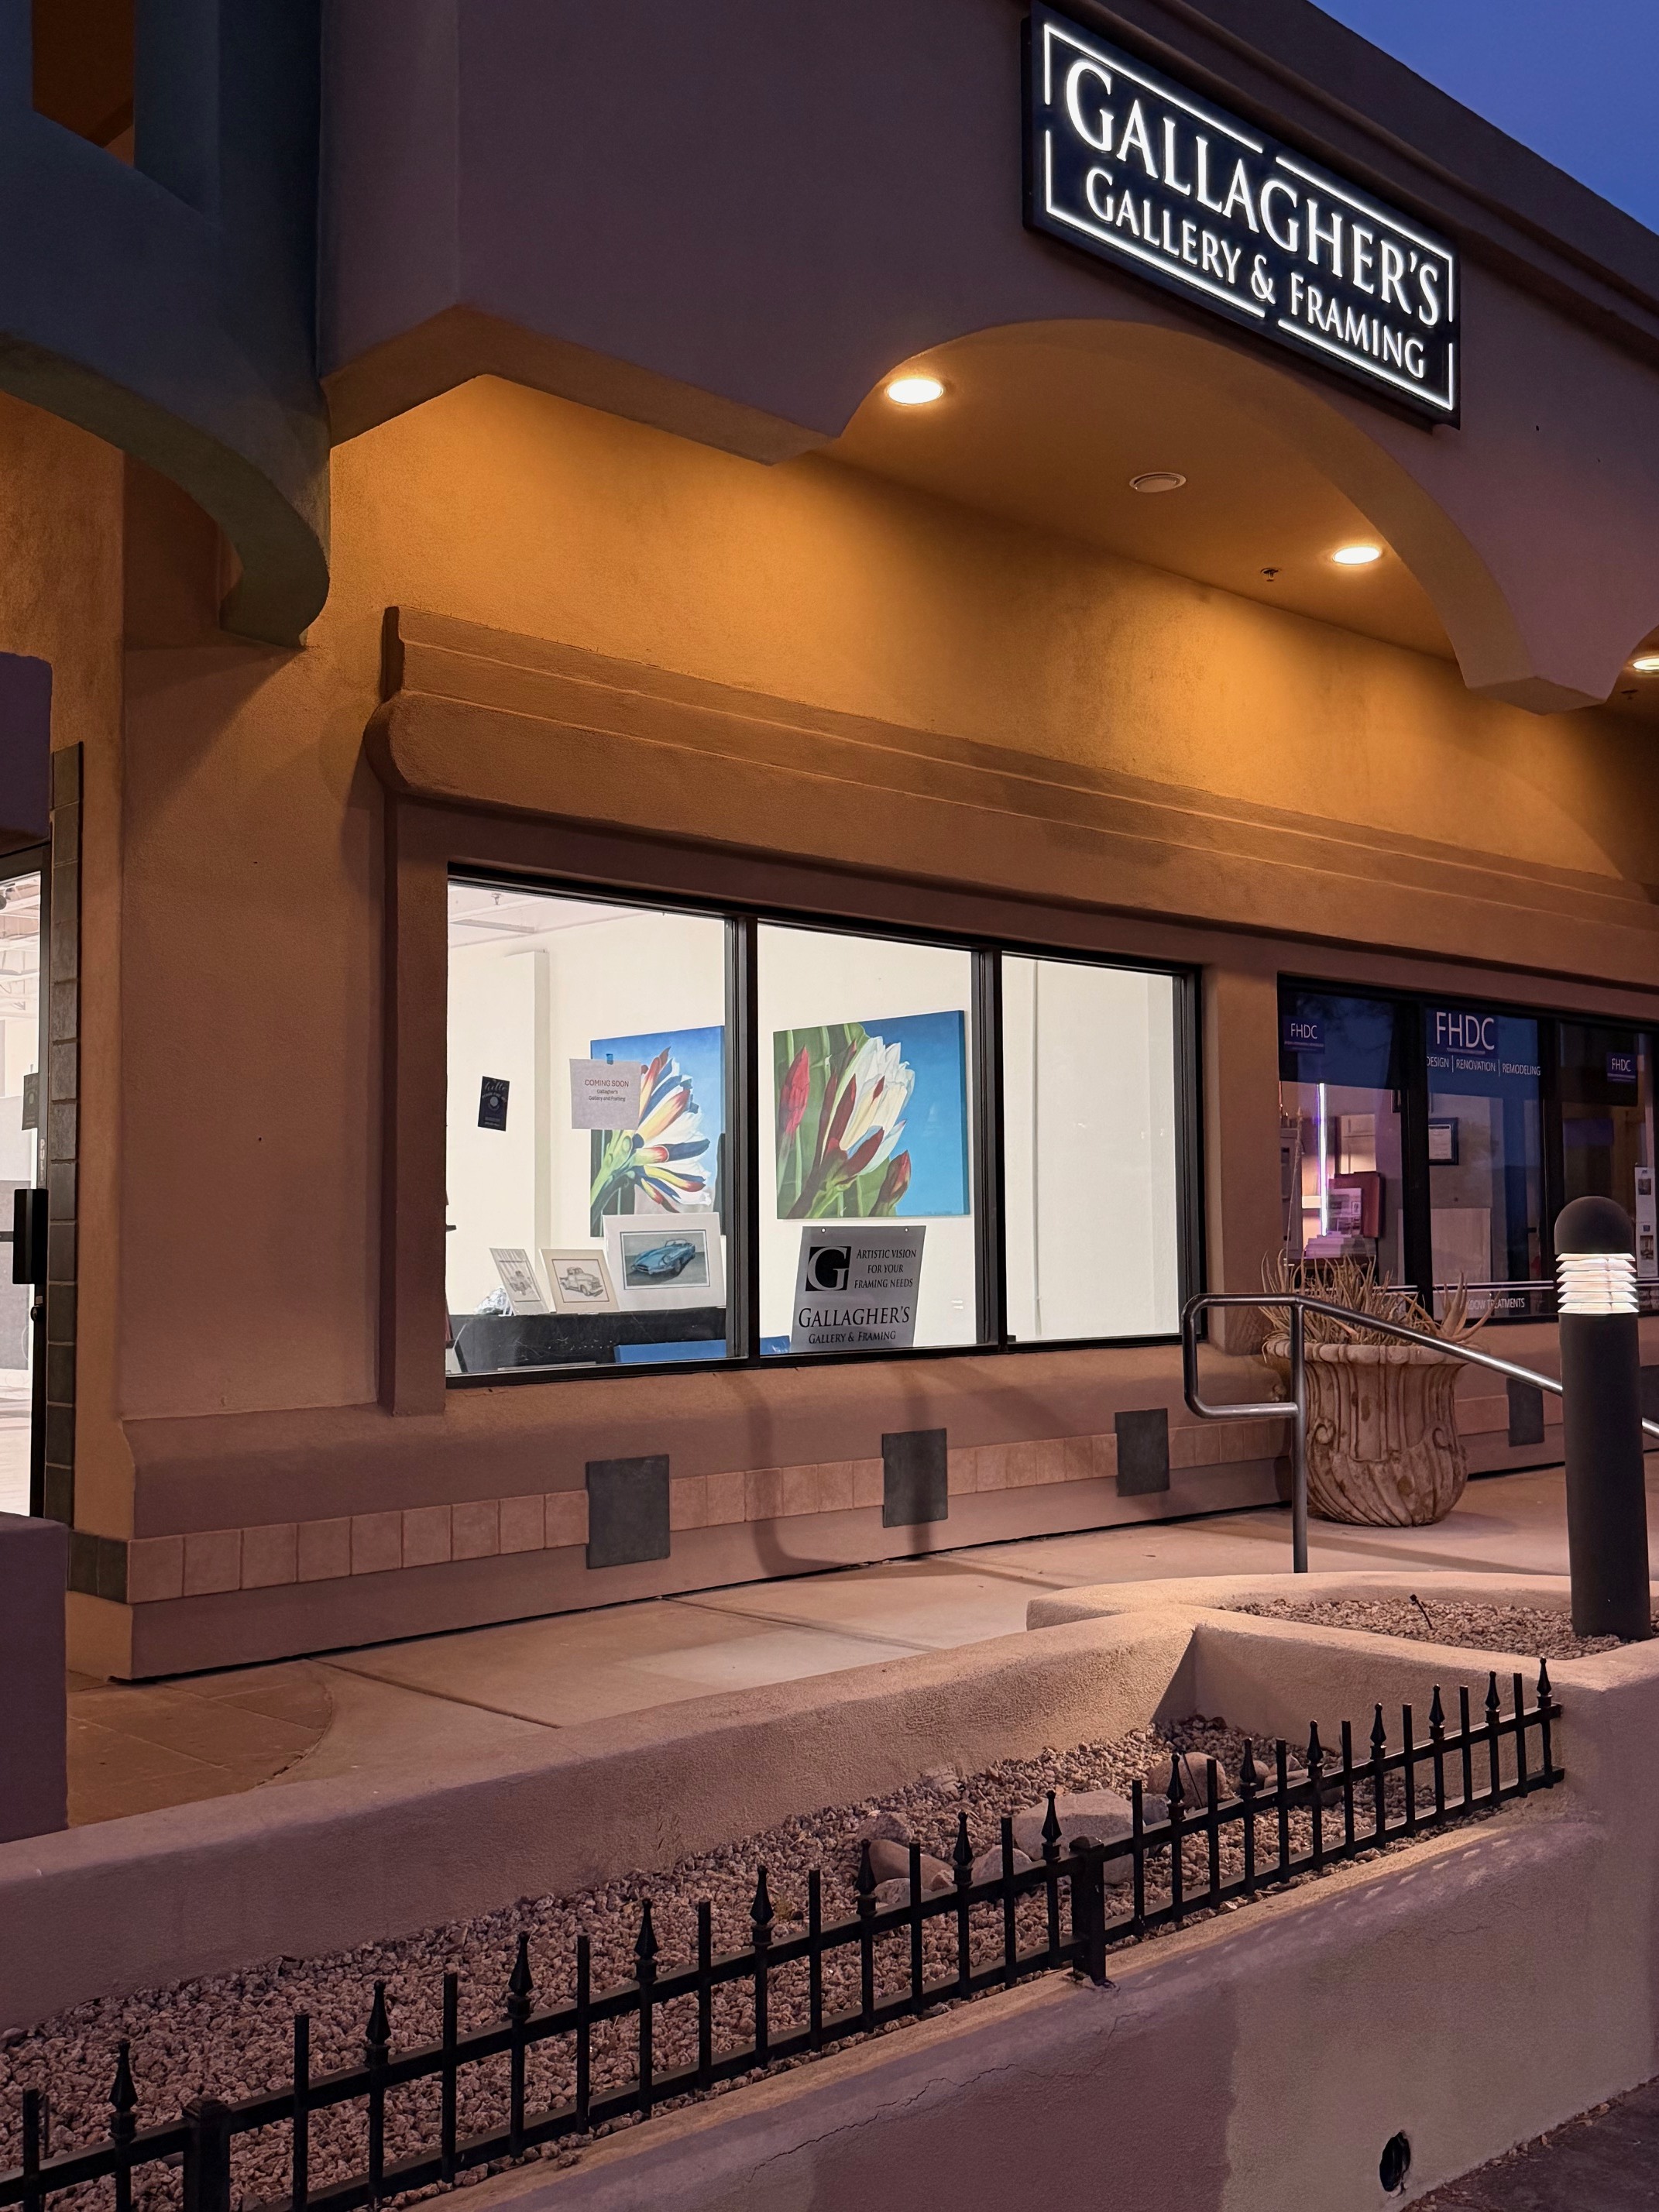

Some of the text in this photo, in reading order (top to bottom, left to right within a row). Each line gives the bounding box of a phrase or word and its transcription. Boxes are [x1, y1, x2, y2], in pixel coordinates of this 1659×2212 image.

[1066, 59, 1439, 327] GALLAGHER'S
[1085, 167, 1425, 379] GALLERY & FRAMING
[1290, 1022, 1318, 1039] FHDC
[1436, 1012, 1495, 1051] FHDC
[1456, 1058, 1496, 1072] RENOVATION
[1502, 1063, 1541, 1076] REMODELING
[1611, 1057, 1631, 1072] FHDC
[856, 1249, 917, 1259] ARTISTIC VISION
[807, 1246, 850, 1291] G
[867, 1264, 904, 1274] FOR YOUR
[854, 1278, 913, 1289] FRAMING NEEDS
[799, 1306, 910, 1328] GALLAGHER'S
[809, 1331, 896, 1344] GALLERY & FRAMING
